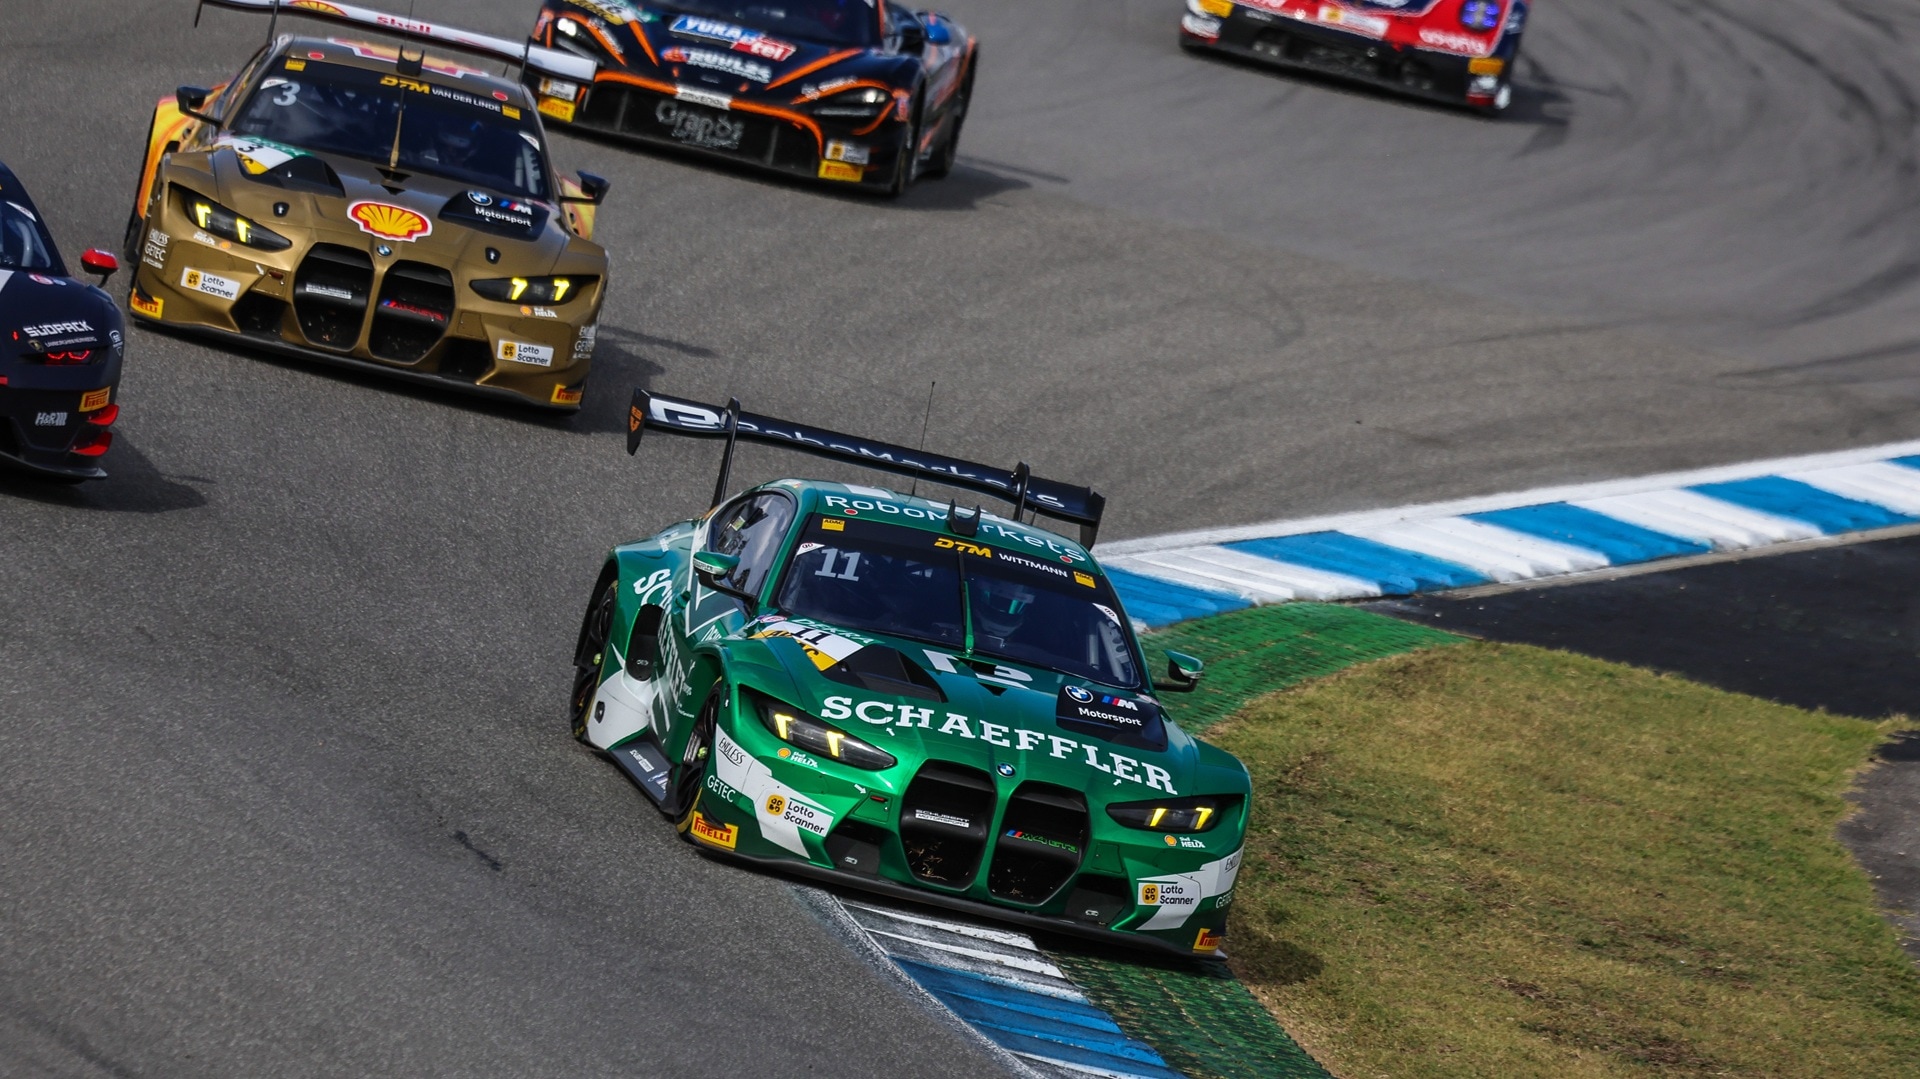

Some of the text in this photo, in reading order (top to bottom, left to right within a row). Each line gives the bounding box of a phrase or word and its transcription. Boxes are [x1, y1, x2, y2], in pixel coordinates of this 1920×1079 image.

[272, 82, 301, 106] 3
[380, 75, 430, 94] DTM
[432, 88, 451, 99] VAN
[453, 93, 472, 105] DER
[473, 99, 501, 112] LINDE
[474, 206, 532, 227] Motorsport
[144, 243, 166, 262] GETEC
[202, 274, 225, 287] Lotto
[200, 283, 234, 299] Scanner
[23, 319, 95, 338] SÜDPACK
[517, 353, 548, 365] Scanner
[518, 344, 540, 355] Lotto
[824, 495, 1085, 563] RoboMrkets
[814, 548, 861, 581] 11
[934, 537, 1068, 578] DTM WITTMANN
[791, 618, 874, 644] DEKRA
[791, 628, 832, 645] 11
[1078, 707, 1142, 726] Motorsport
[718, 736, 746, 765] ENDLESS
[820, 695, 1178, 796] SCHAEFFLER
[790, 756, 818, 768] HELIX
[707, 774, 736, 803] GETEC
[787, 801, 815, 819] Lotto
[915, 809, 969, 822] SCHUBERT
[693, 816, 732, 843] PIRELLI
[783, 811, 825, 834] Scanner
[1180, 839, 1206, 848] HELIX
[1160, 884, 1184, 894] Lotto
[1159, 895, 1194, 905] Scanner
